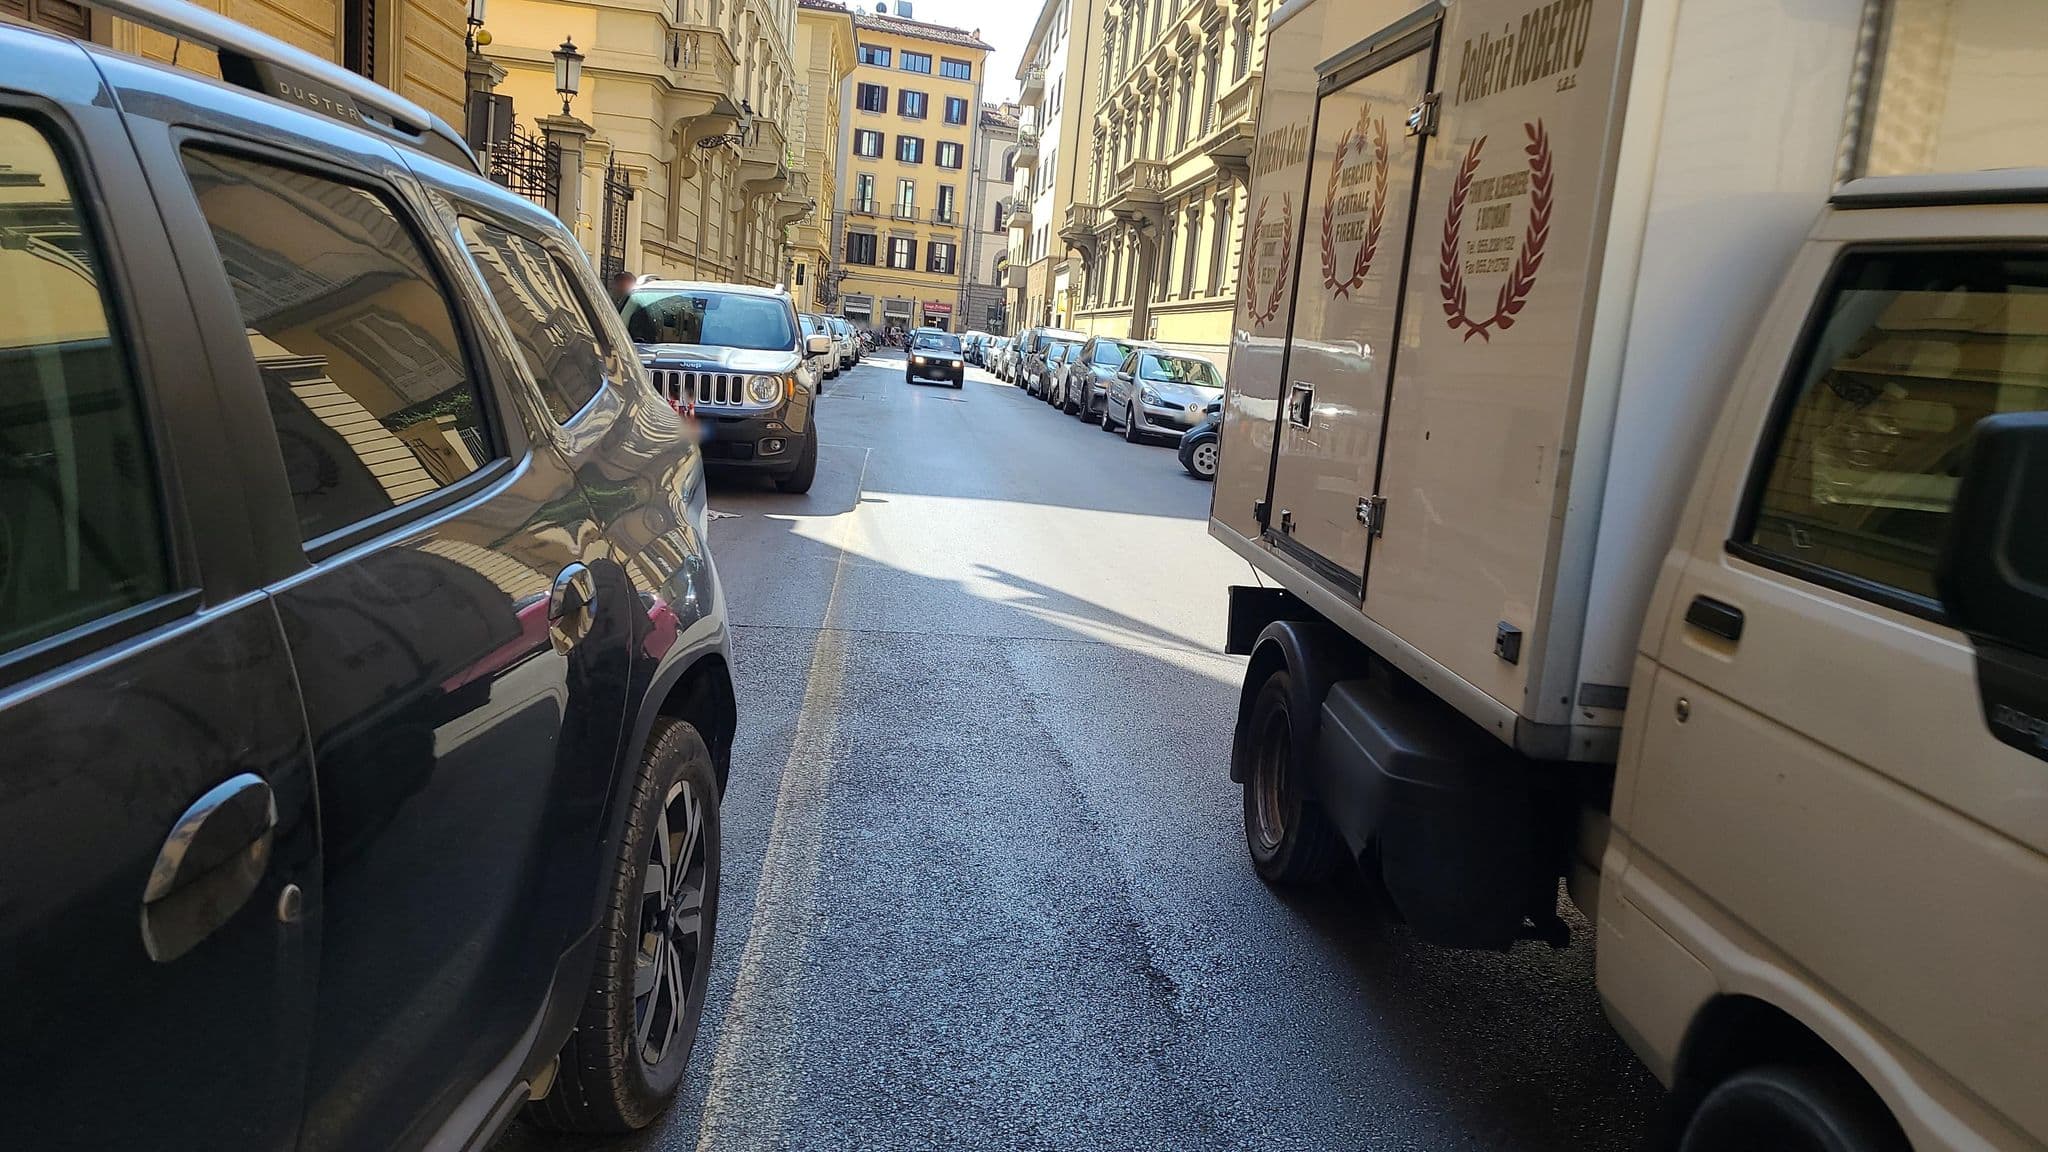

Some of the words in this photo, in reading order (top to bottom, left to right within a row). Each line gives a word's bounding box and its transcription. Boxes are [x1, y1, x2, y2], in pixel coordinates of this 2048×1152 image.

[1455, 22, 1515, 107] Polleria
[1510, 0, 1594, 88] ROBERTO
[279, 81, 359, 121] DUSTER
[1340, 160, 1374, 189] MERCATO
[1336, 190, 1370, 217] CENTRALE
[1335, 219, 1365, 243] FIRENZE
